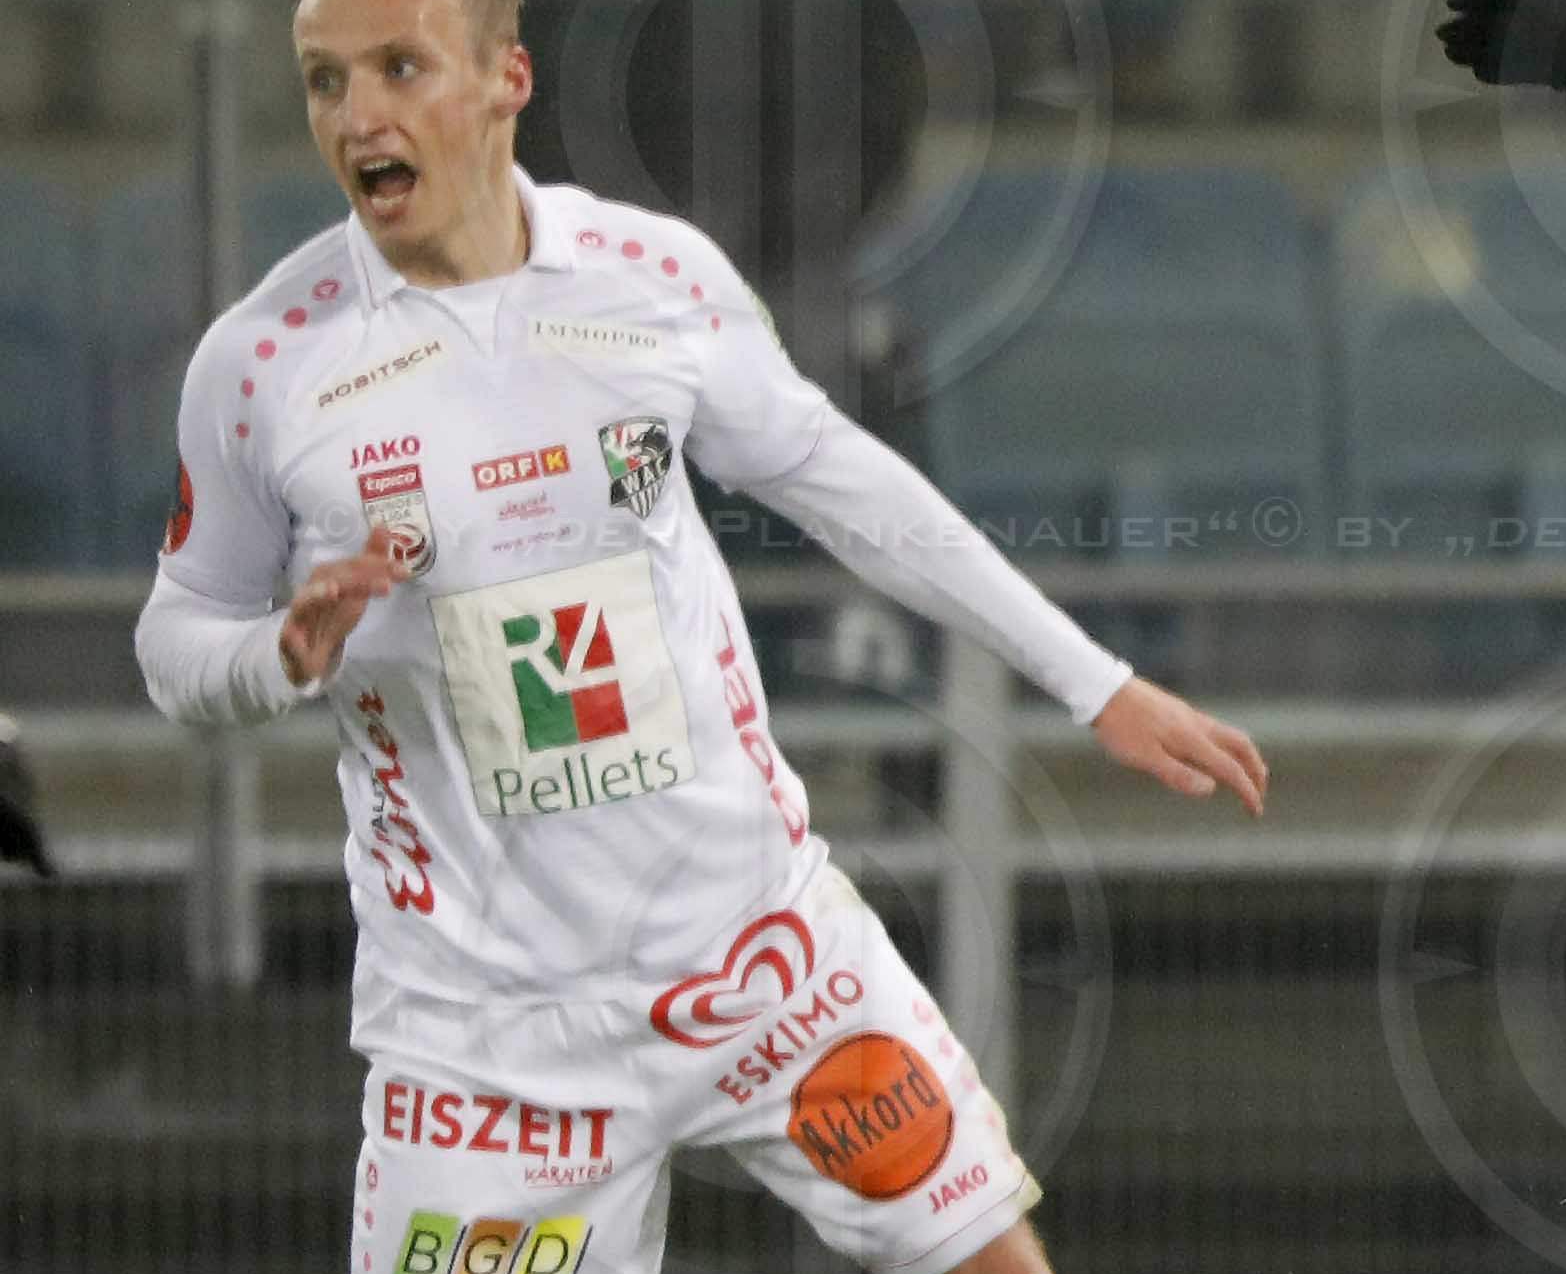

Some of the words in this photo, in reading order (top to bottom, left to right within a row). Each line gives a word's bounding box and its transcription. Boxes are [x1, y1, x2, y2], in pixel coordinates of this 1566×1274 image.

[319, 341, 443, 407] ROBITSCH
[350, 436, 420, 470] JAKO
[478, 457, 535, 486] ORF
[545, 445, 566, 472] K
[492, 746, 679, 817] Pellets
[716, 970, 866, 1106] ESKIMO
[384, 1082, 615, 1160] EISZEIT
[799, 1052, 939, 1173] Akkord
[927, 1165, 991, 1215] JAKO
